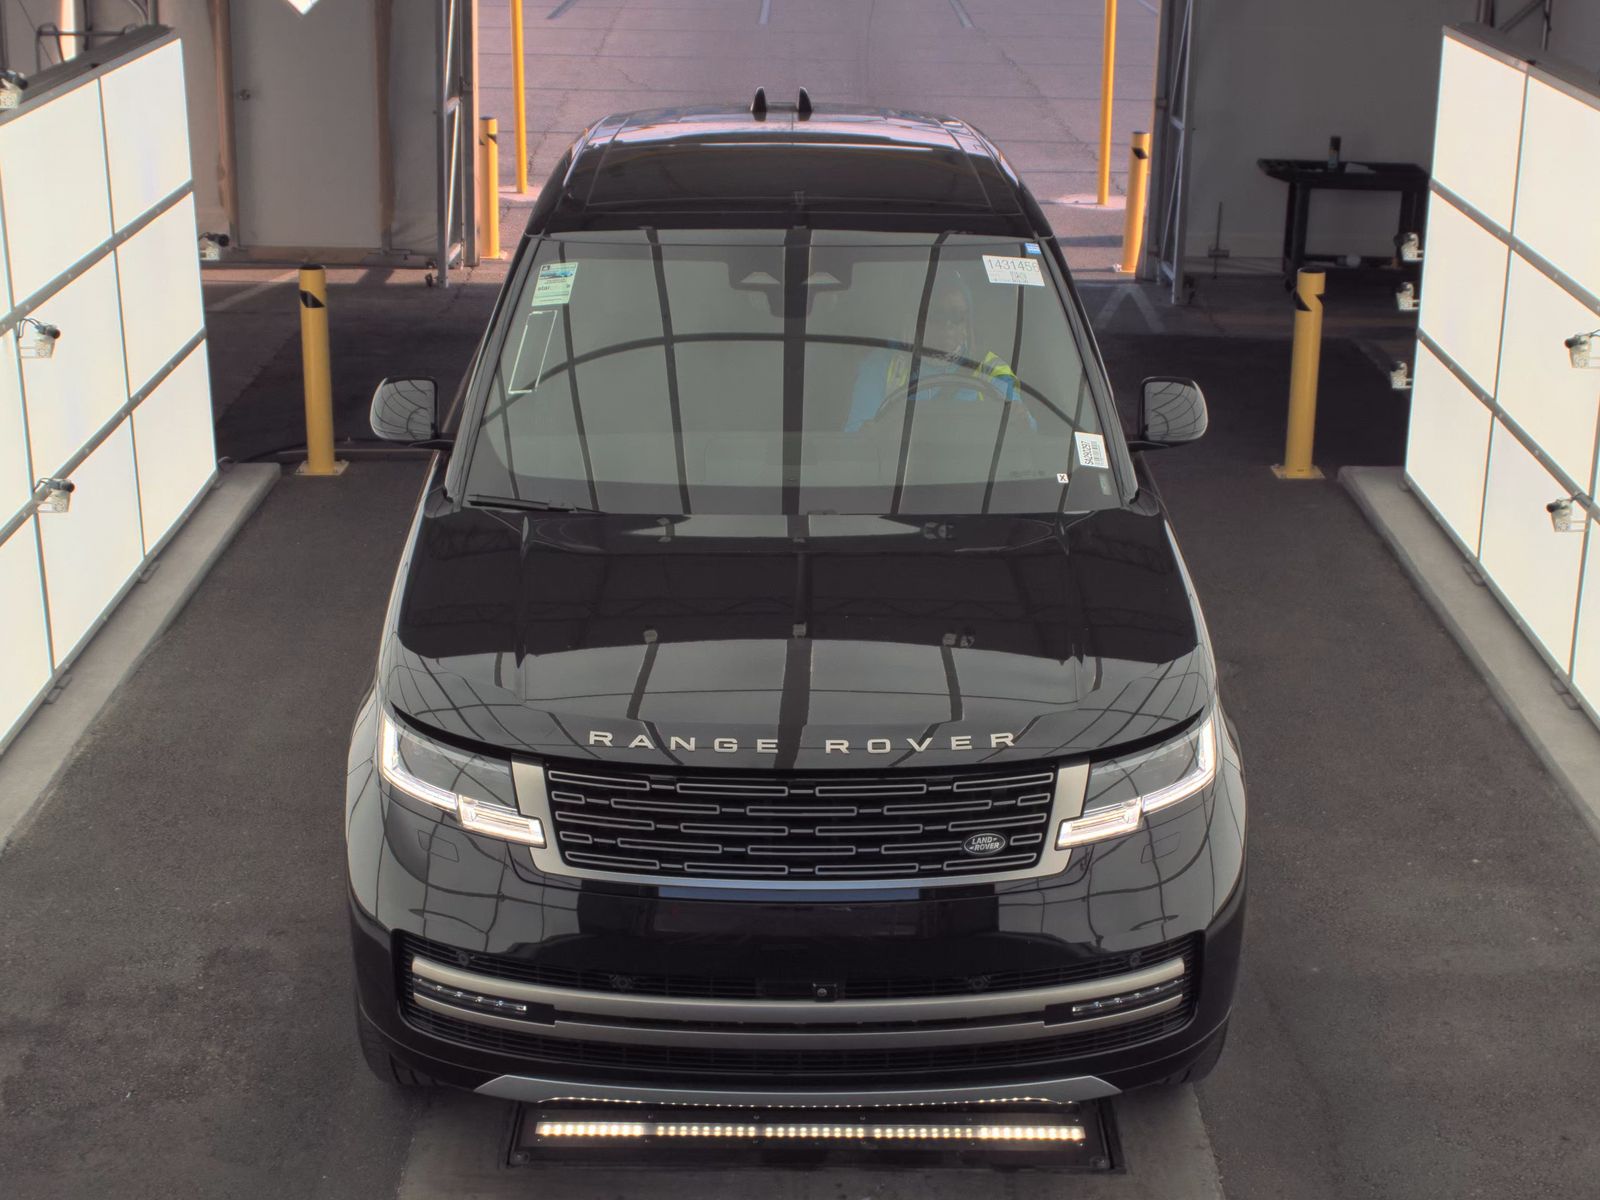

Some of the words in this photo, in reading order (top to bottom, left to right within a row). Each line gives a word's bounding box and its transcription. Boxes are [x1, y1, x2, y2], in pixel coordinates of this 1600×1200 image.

[589, 730, 779, 753] RANGE
[825, 732, 1015, 754] ROVER
[972, 836, 992, 845] LAND
[974, 842, 1000, 851] ROVER
